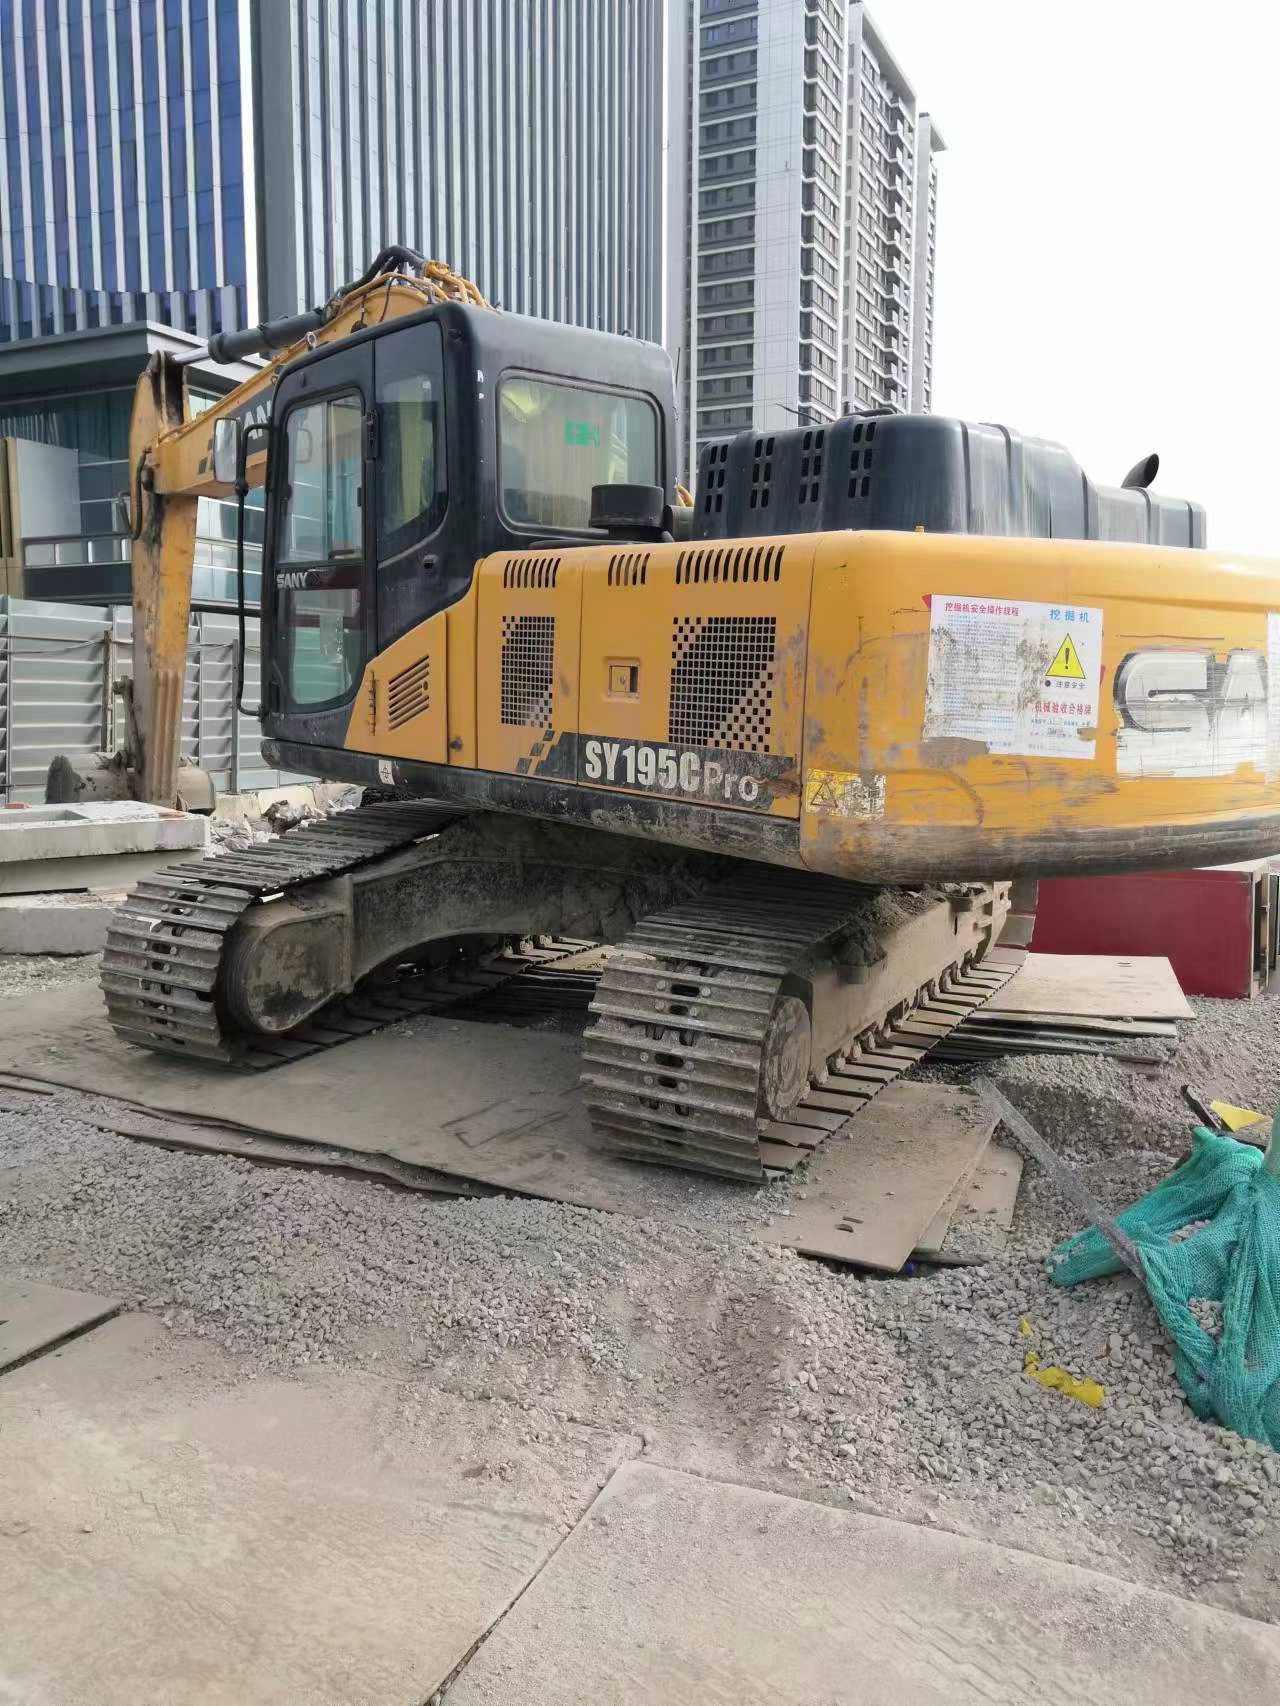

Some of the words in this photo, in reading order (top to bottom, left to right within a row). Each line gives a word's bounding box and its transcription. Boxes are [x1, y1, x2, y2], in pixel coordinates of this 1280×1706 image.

[276, 572, 308, 589] SANY
[1049, 609, 1090, 623] 挖掘机
[585, 740, 700, 793] SY195C
[703, 761, 760, 801] Pro
